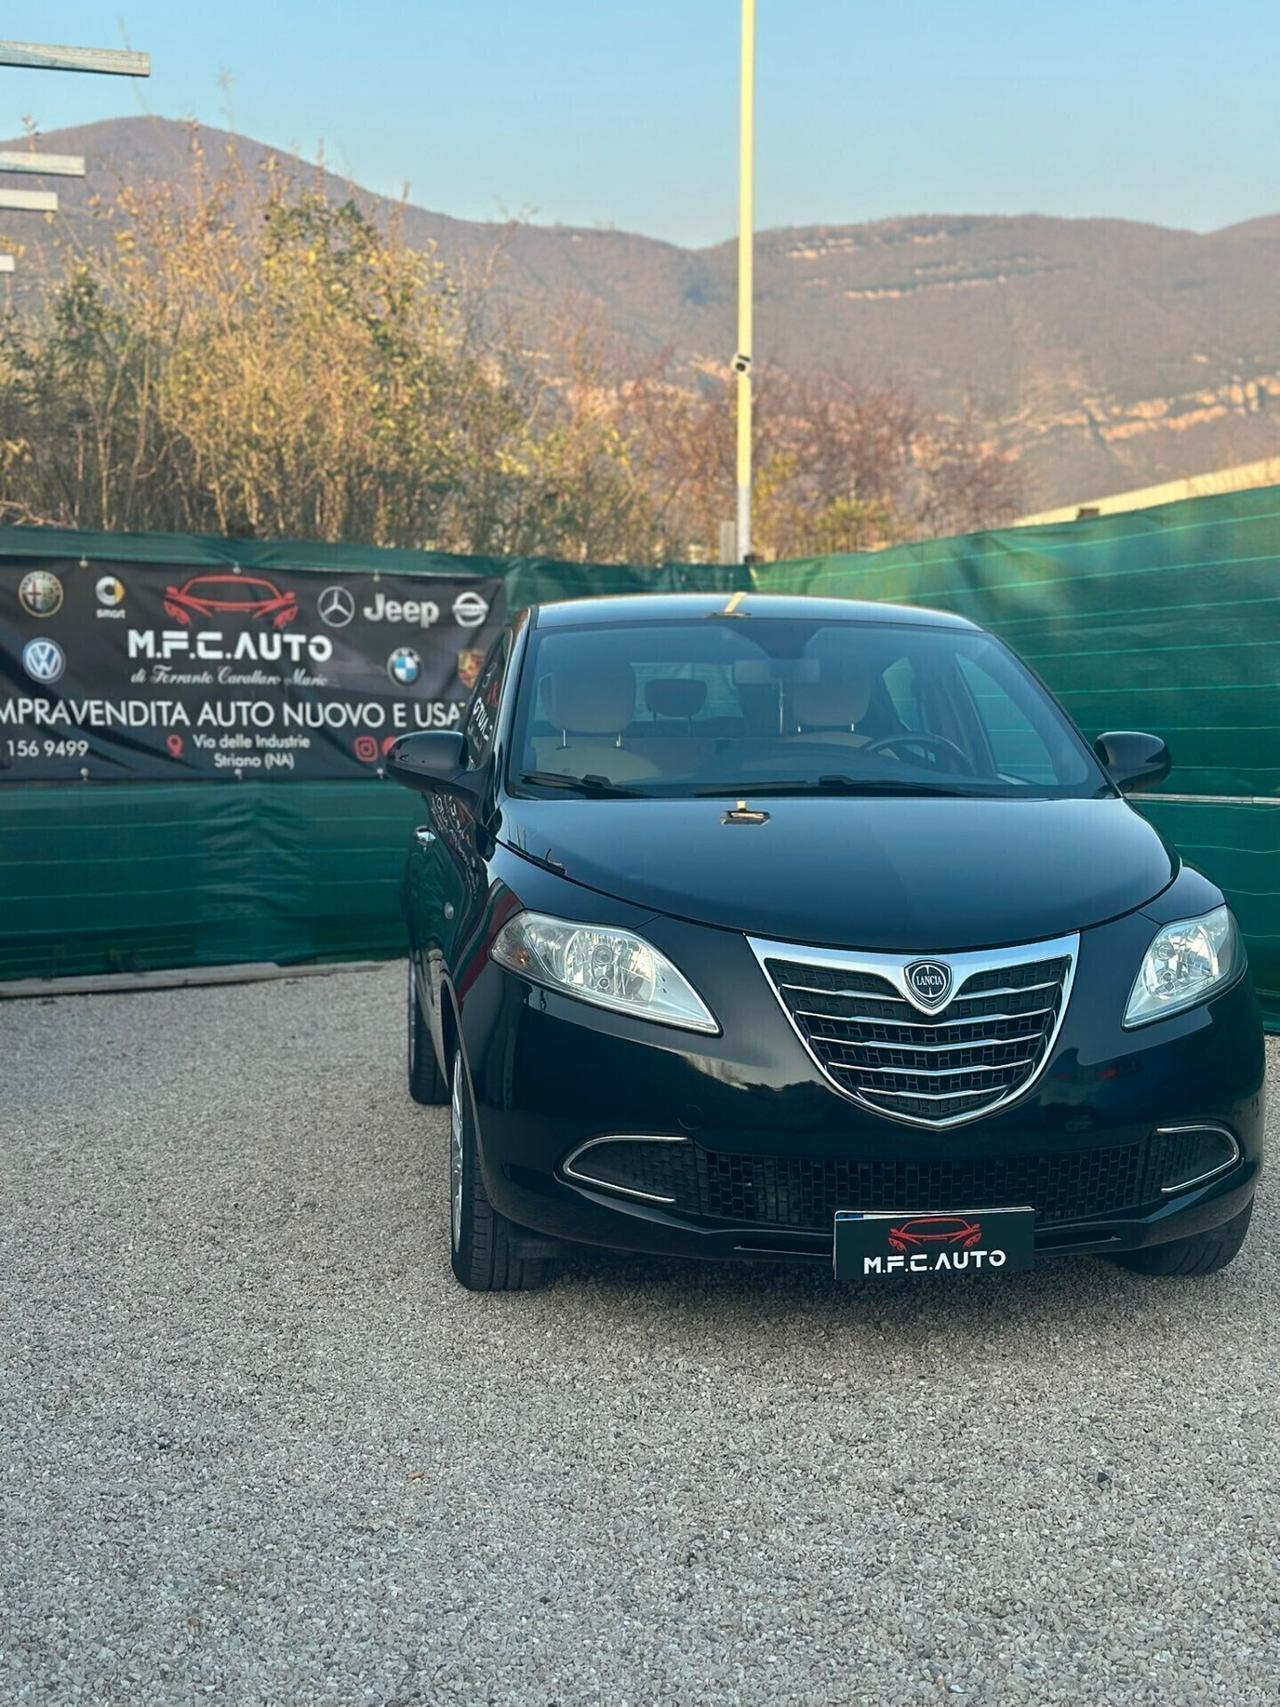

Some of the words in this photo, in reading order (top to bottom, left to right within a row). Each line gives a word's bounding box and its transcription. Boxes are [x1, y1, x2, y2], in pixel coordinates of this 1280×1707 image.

[96, 608, 126, 619] smart
[363, 593, 440, 628] Jeep
[128, 629, 333, 662] M.F.C.AUTO
[130, 668, 147, 683] di
[197, 701, 275, 728] AUTO
[283, 702, 385, 728] NUOVO
[393, 703, 407, 728] E
[414, 702, 465, 728] USA
[6, 739, 40, 757] 156
[43, 739, 89, 757] 9499
[192, 733, 216, 749] Via
[219, 733, 253, 749] delle
[255, 733, 311, 749] Industrie
[214, 752, 262, 768] Striano
[264, 752, 295, 770] (NA)
[915, 975, 944, 986] LANCIA
[864, 1249, 1007, 1275] M.F.C.AUTO
